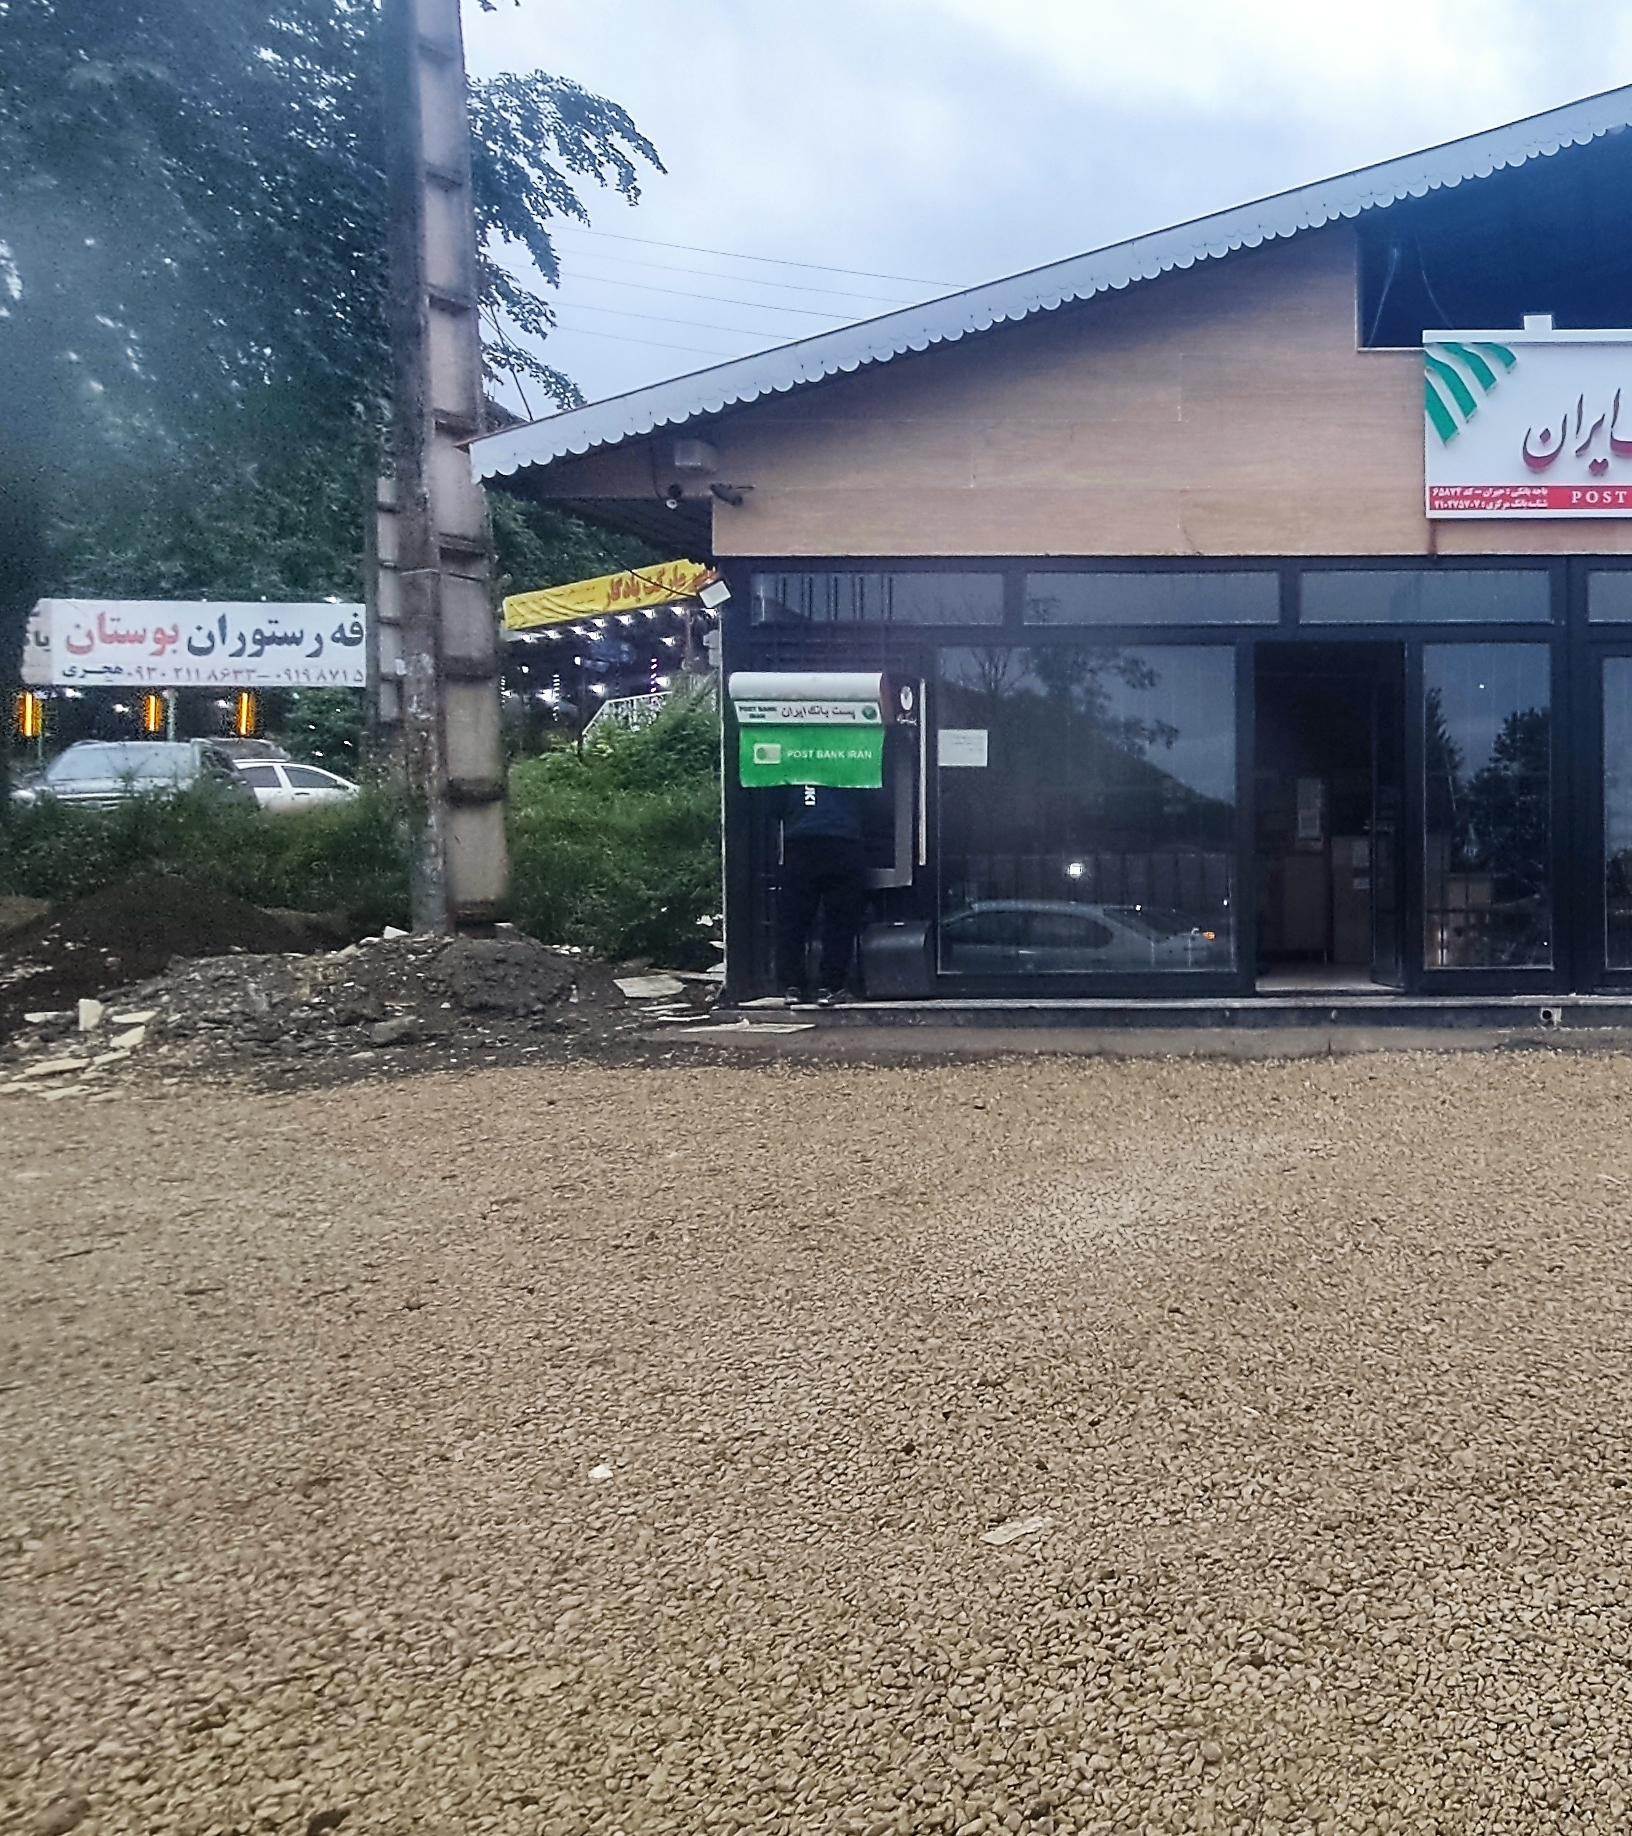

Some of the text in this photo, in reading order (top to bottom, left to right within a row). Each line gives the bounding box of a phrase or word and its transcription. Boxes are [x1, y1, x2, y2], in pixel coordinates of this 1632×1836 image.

[1521, 387, 1621, 476] ایران
[1571, 490, 1628, 504] POST
[65, 611, 365, 658] فه رستوران بوستان
[781, 706, 806, 719] ایران
[832, 706, 856, 720] پست
[787, 749, 873, 759] POST BANK IRAN
